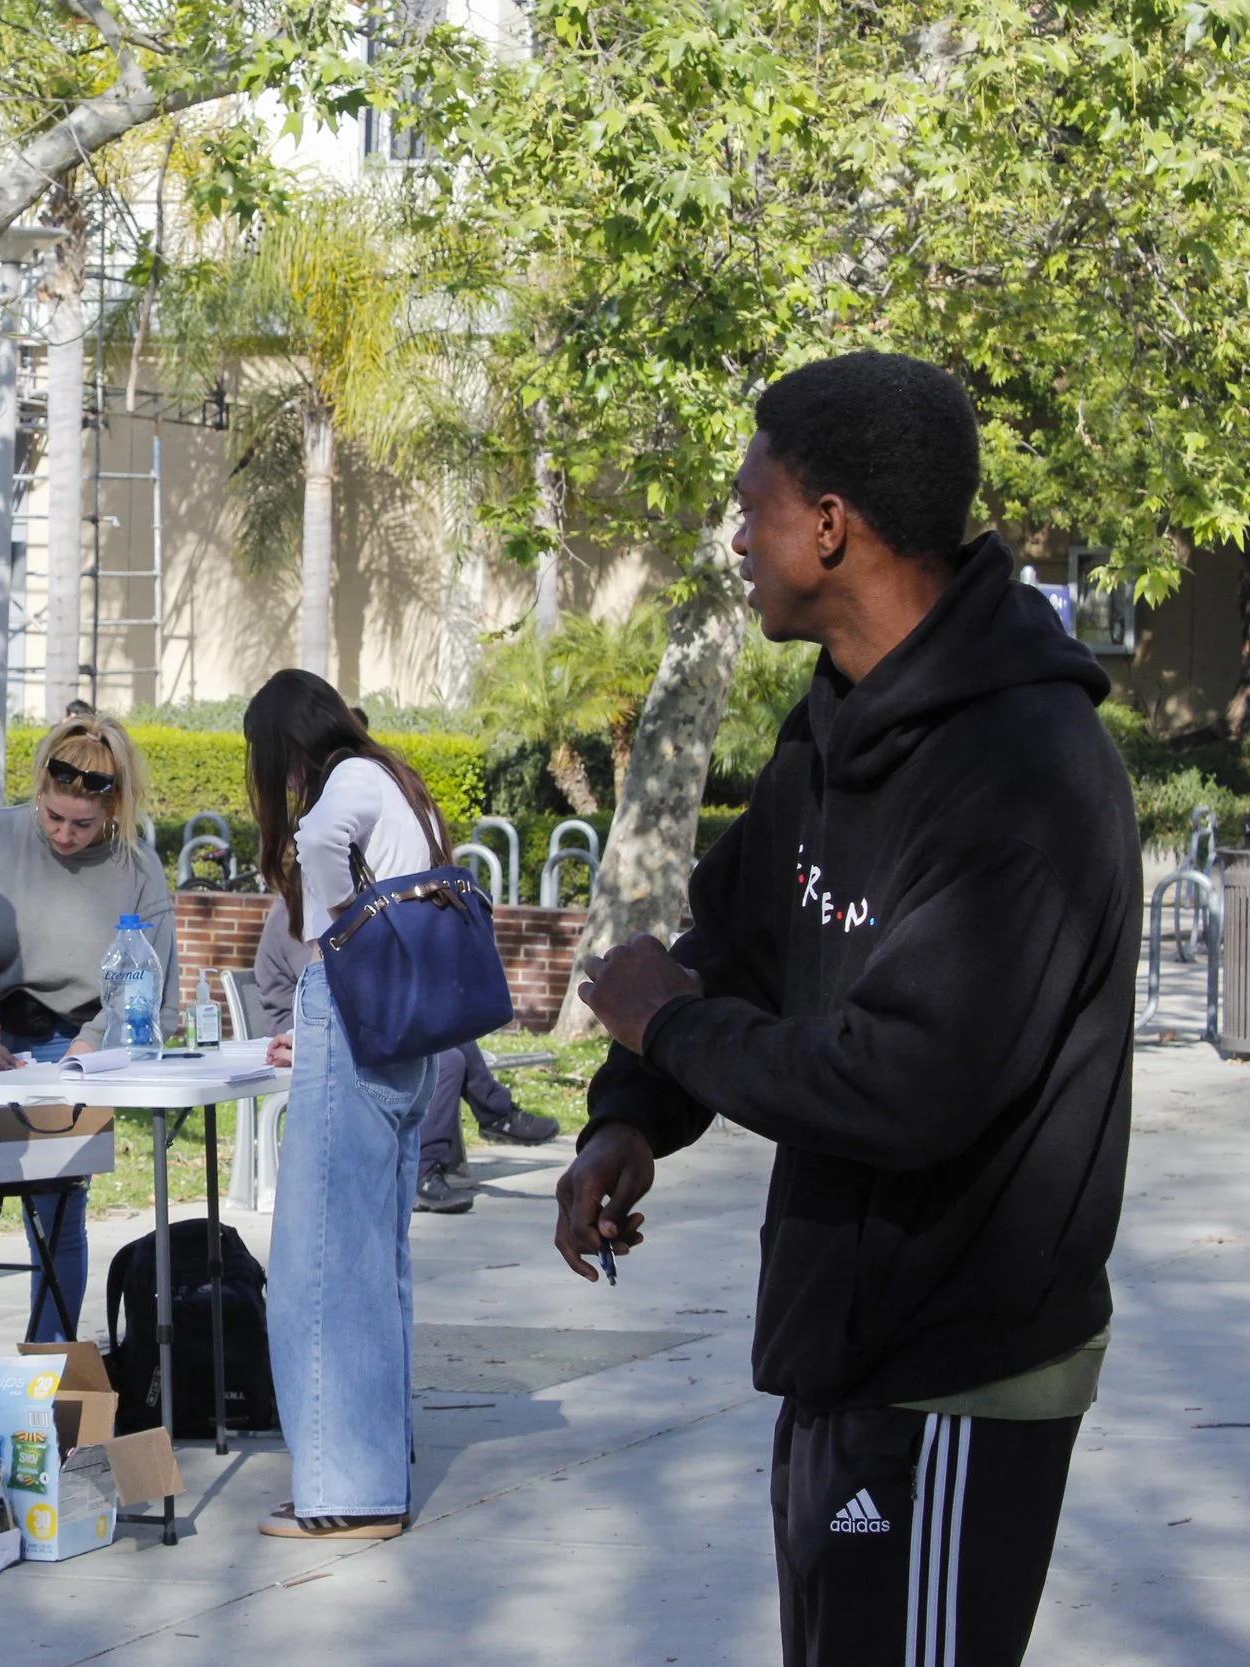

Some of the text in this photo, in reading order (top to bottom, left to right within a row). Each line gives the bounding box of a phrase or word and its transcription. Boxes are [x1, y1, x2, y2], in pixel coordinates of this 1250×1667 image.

[105, 969, 144, 980] Eternal
[37, 1376, 53, 1390] 30
[33, 1510, 50, 1528] 30
[830, 1518, 890, 1533] adidas
